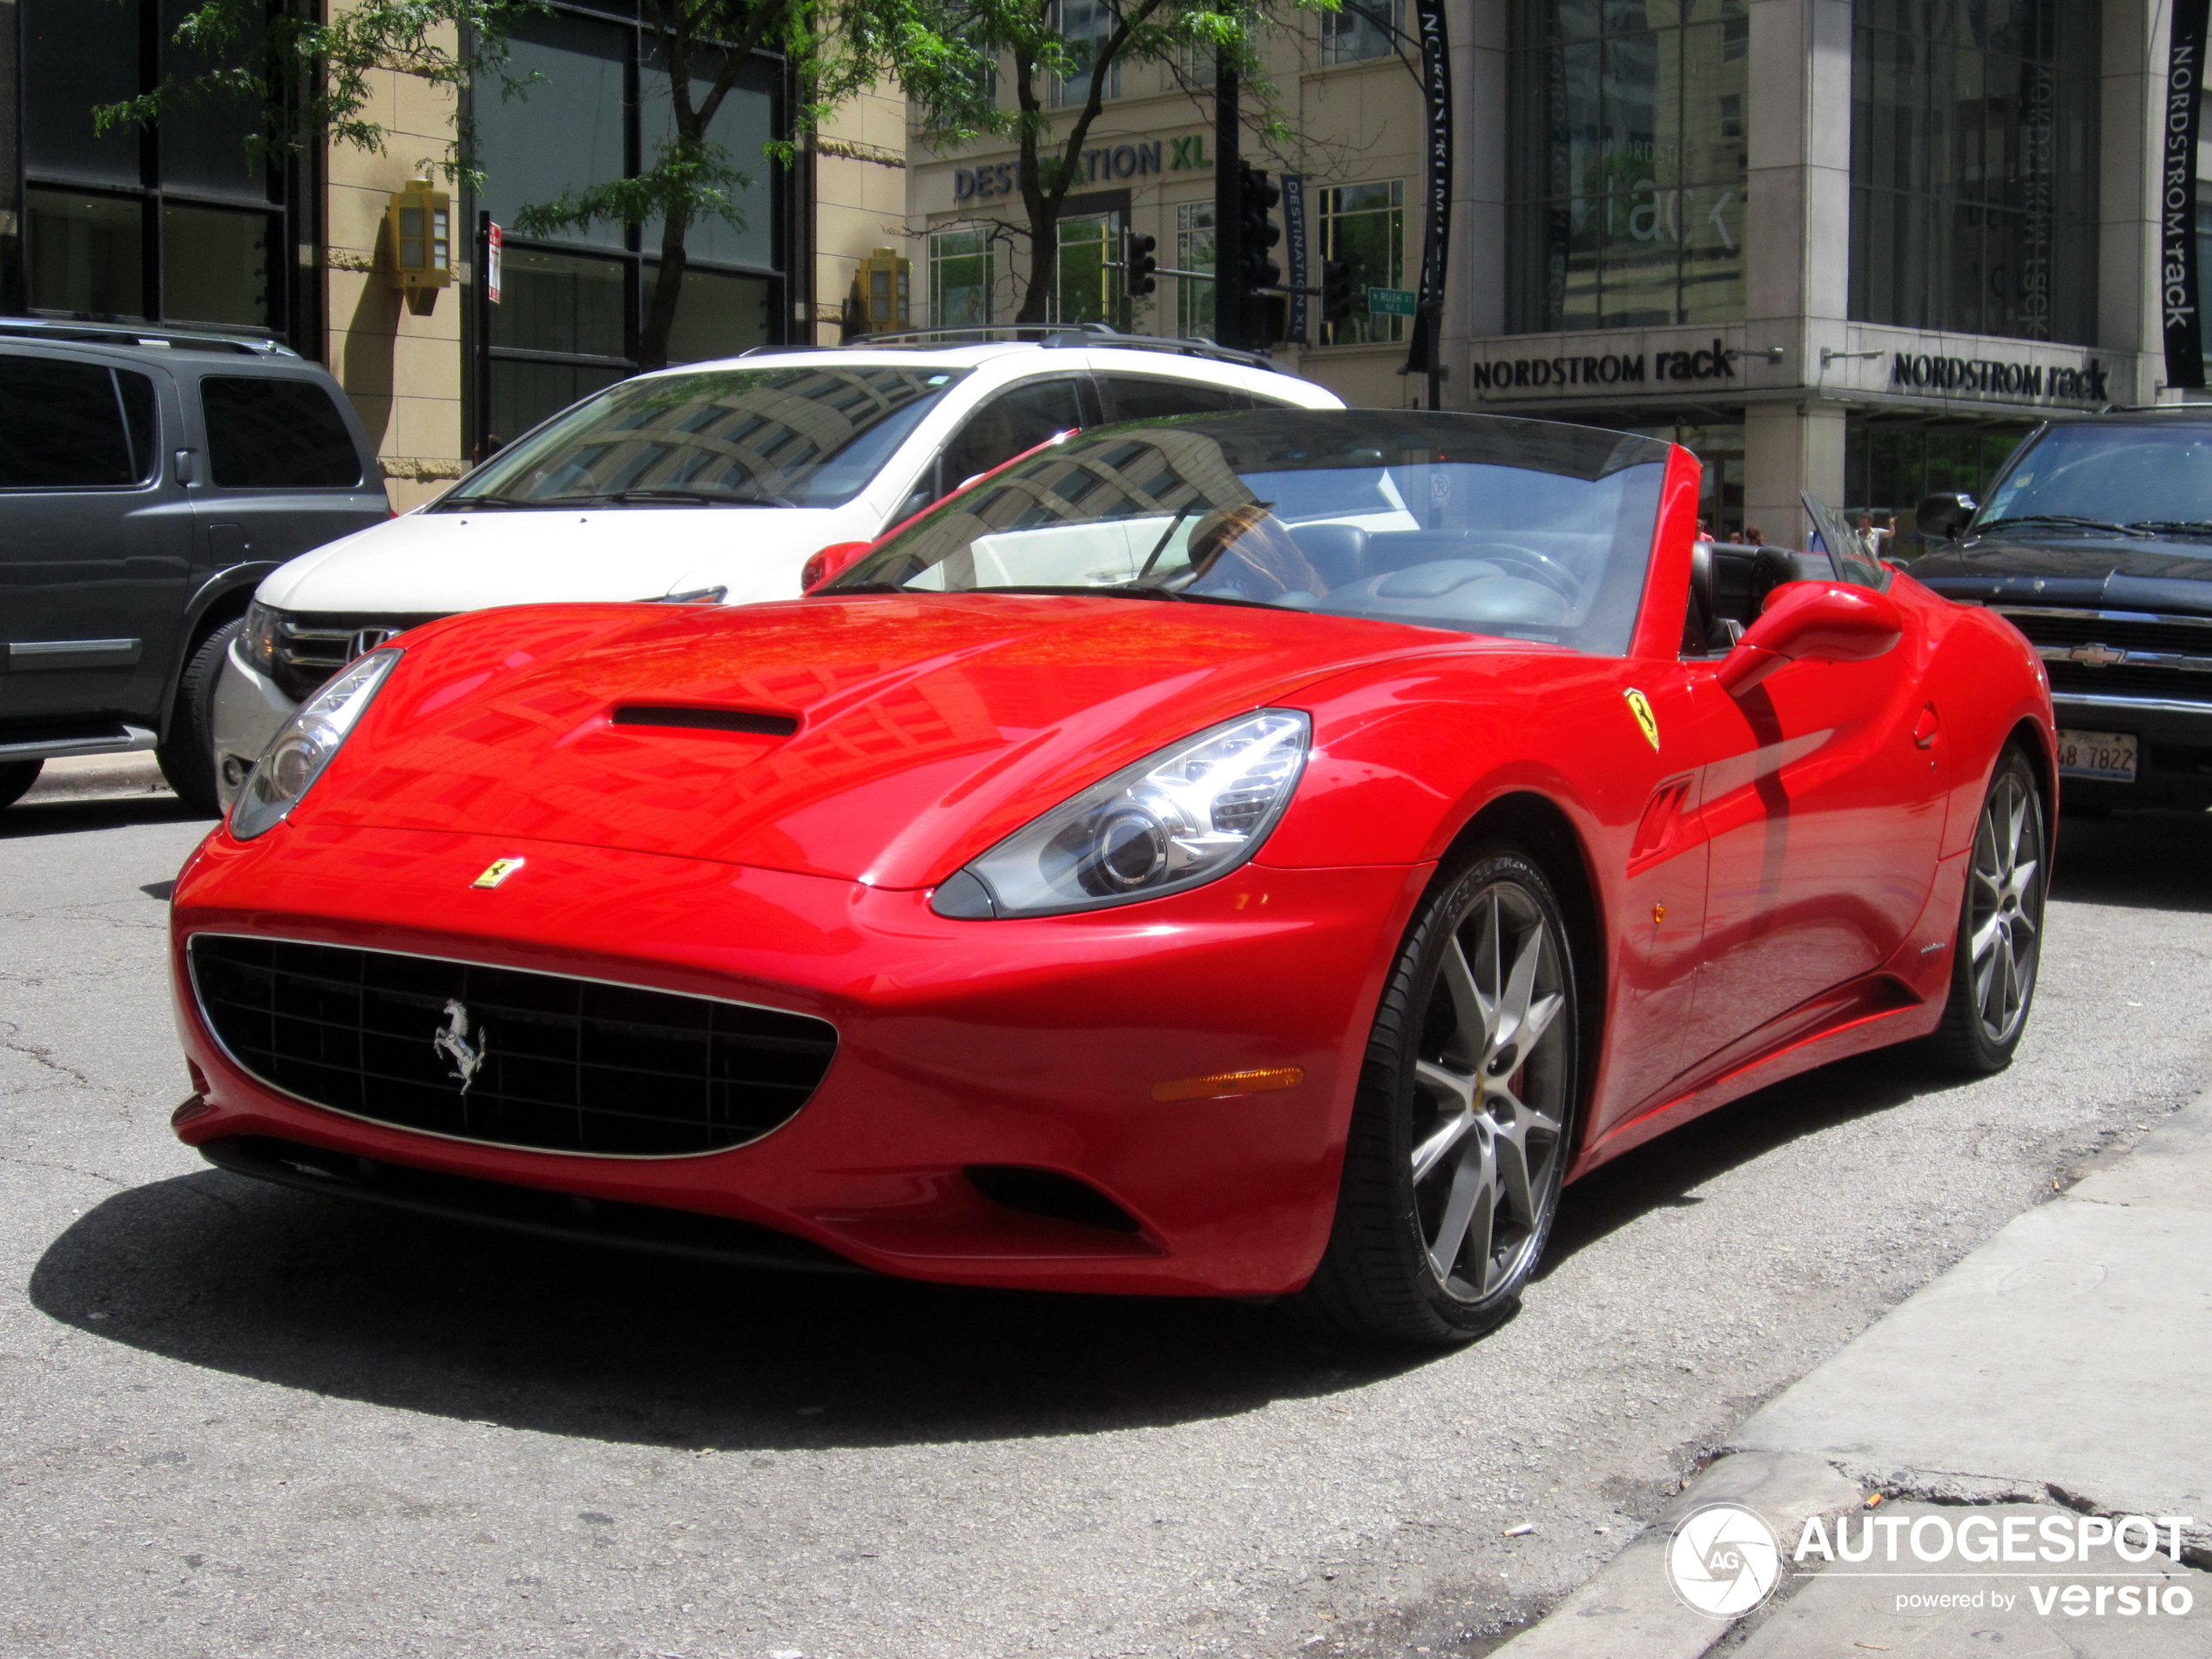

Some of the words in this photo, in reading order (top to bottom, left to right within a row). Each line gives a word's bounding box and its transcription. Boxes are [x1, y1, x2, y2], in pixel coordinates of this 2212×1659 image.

[1170, 135, 1214, 171] XL
[2166, 46, 2194, 236] NORDSTROM
[1380, 292, 1401, 302] RUSH
[2166, 248, 2194, 328] rack
[1294, 313, 1305, 334] XL
[1474, 354, 1644, 388] NORDSTROM
[1656, 338, 1735, 381] rack
[1894, 352, 2043, 396] NORDSTROM
[2048, 358, 2108, 401] rack
[2087, 747, 2133, 772] 7822
